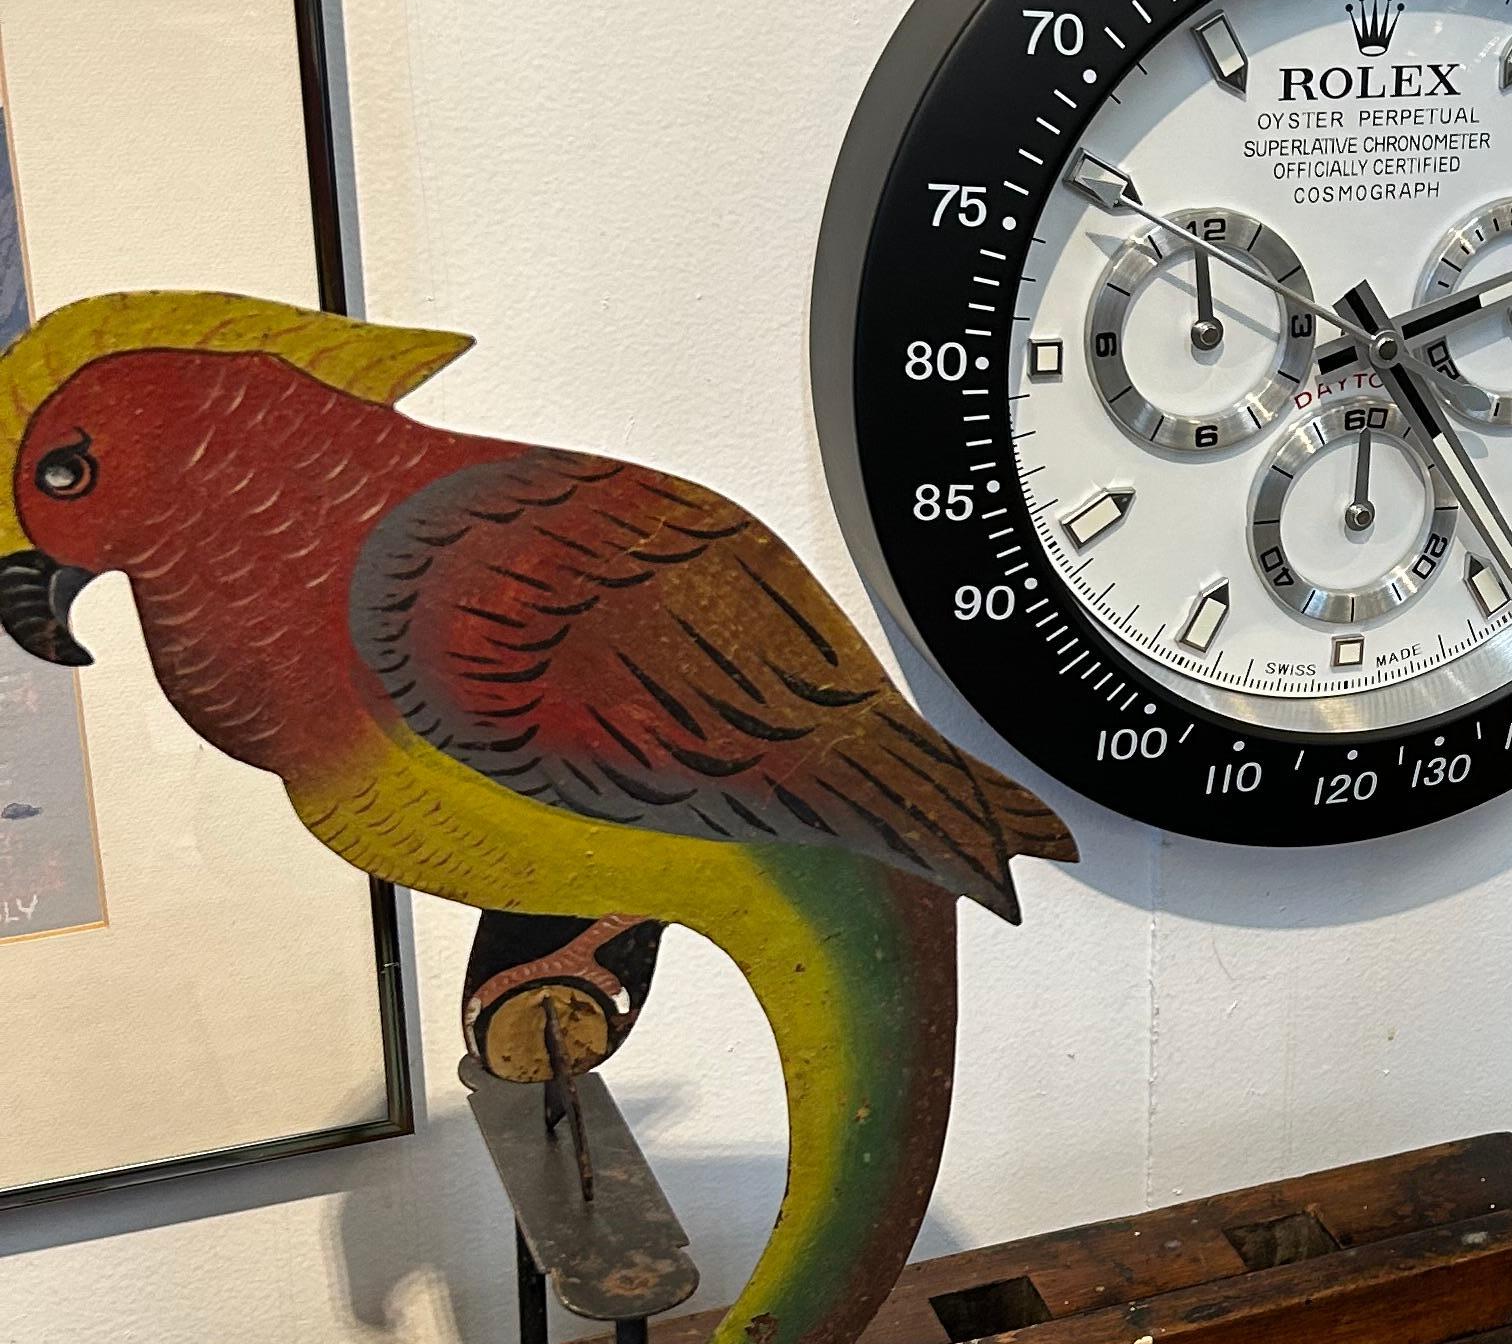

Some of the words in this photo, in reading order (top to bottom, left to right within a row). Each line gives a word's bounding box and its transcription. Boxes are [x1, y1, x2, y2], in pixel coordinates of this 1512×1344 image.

[1022, 9, 1084, 56] 70
[1278, 63, 1462, 102] ROLEX
[1257, 111, 1344, 130] OYSTER
[1359, 107, 1480, 127] PERPETUAL
[1243, 137, 1358, 158] SUPERLATIVE
[1363, 132, 1491, 154] CHRONOMETER
[1273, 159, 1368, 180] OFFICIALLY
[1372, 155, 1461, 176] CERTIFIED
[927, 183, 987, 228] 75
[1294, 181, 1440, 204] COSMOGRAPH
[1186, 218, 1226, 241] 12
[904, 341, 969, 382] 80
[1294, 372, 1386, 411] DAYTO
[1195, 424, 1219, 449] 6
[1344, 407, 1389, 431] 60
[913, 483, 974, 522] 85
[1260, 545, 1294, 586] 40
[1412, 533, 1448, 580] 20
[953, 585, 1016, 621] 90
[1264, 662, 1316, 677] SWISS
[1376, 642, 1423, 668] MADE
[1096, 727, 1168, 761] 100
[1205, 761, 1262, 795] 110
[1314, 771, 1378, 806] 120
[1411, 754, 1472, 788] 130
